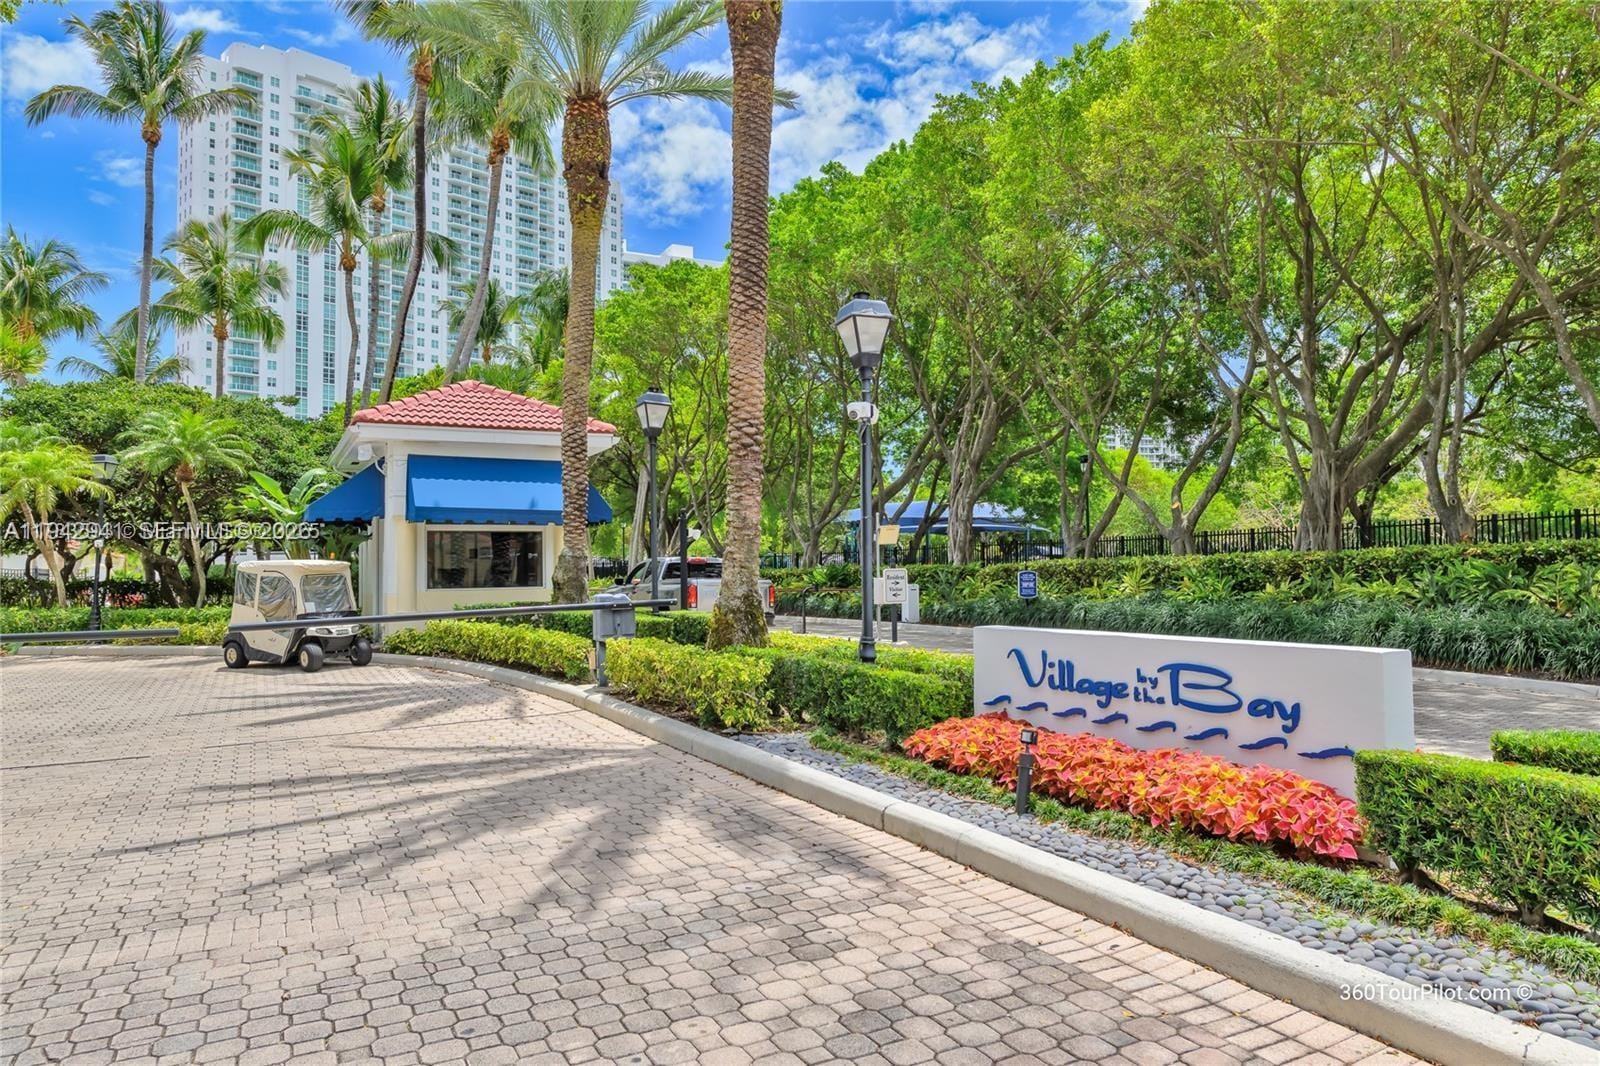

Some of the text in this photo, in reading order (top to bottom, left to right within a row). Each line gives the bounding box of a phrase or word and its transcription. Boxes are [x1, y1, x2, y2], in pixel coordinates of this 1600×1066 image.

[1007, 648, 1301, 734] Village by the Bay
